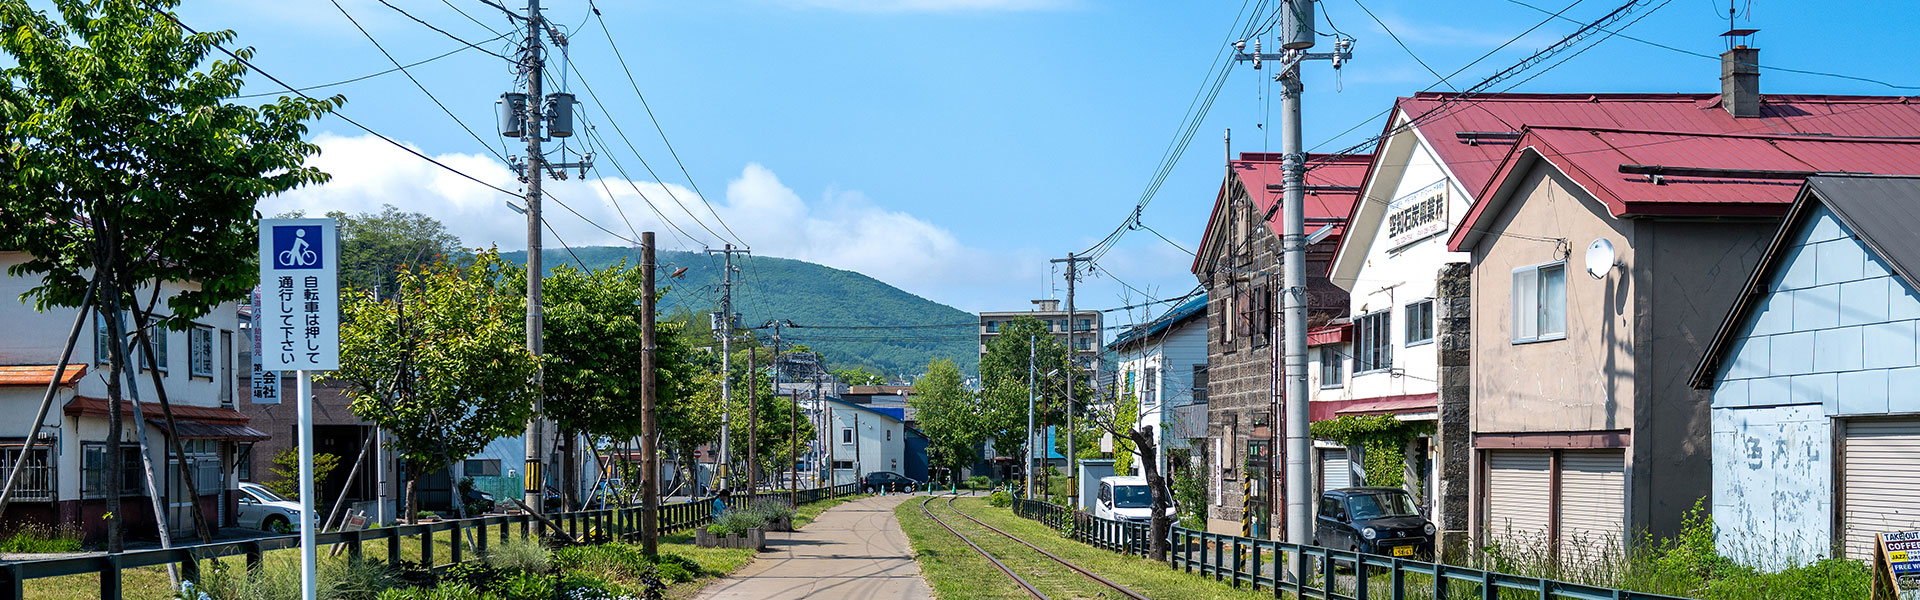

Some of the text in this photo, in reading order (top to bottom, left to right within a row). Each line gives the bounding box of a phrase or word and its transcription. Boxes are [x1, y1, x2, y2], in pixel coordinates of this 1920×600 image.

[278, 276, 295, 364] 通行して下さい
[304, 276, 320, 364] 自転車は押して
[1884, 532, 1919, 541] TAKE OUT
[1894, 563, 1912, 571] FREE
